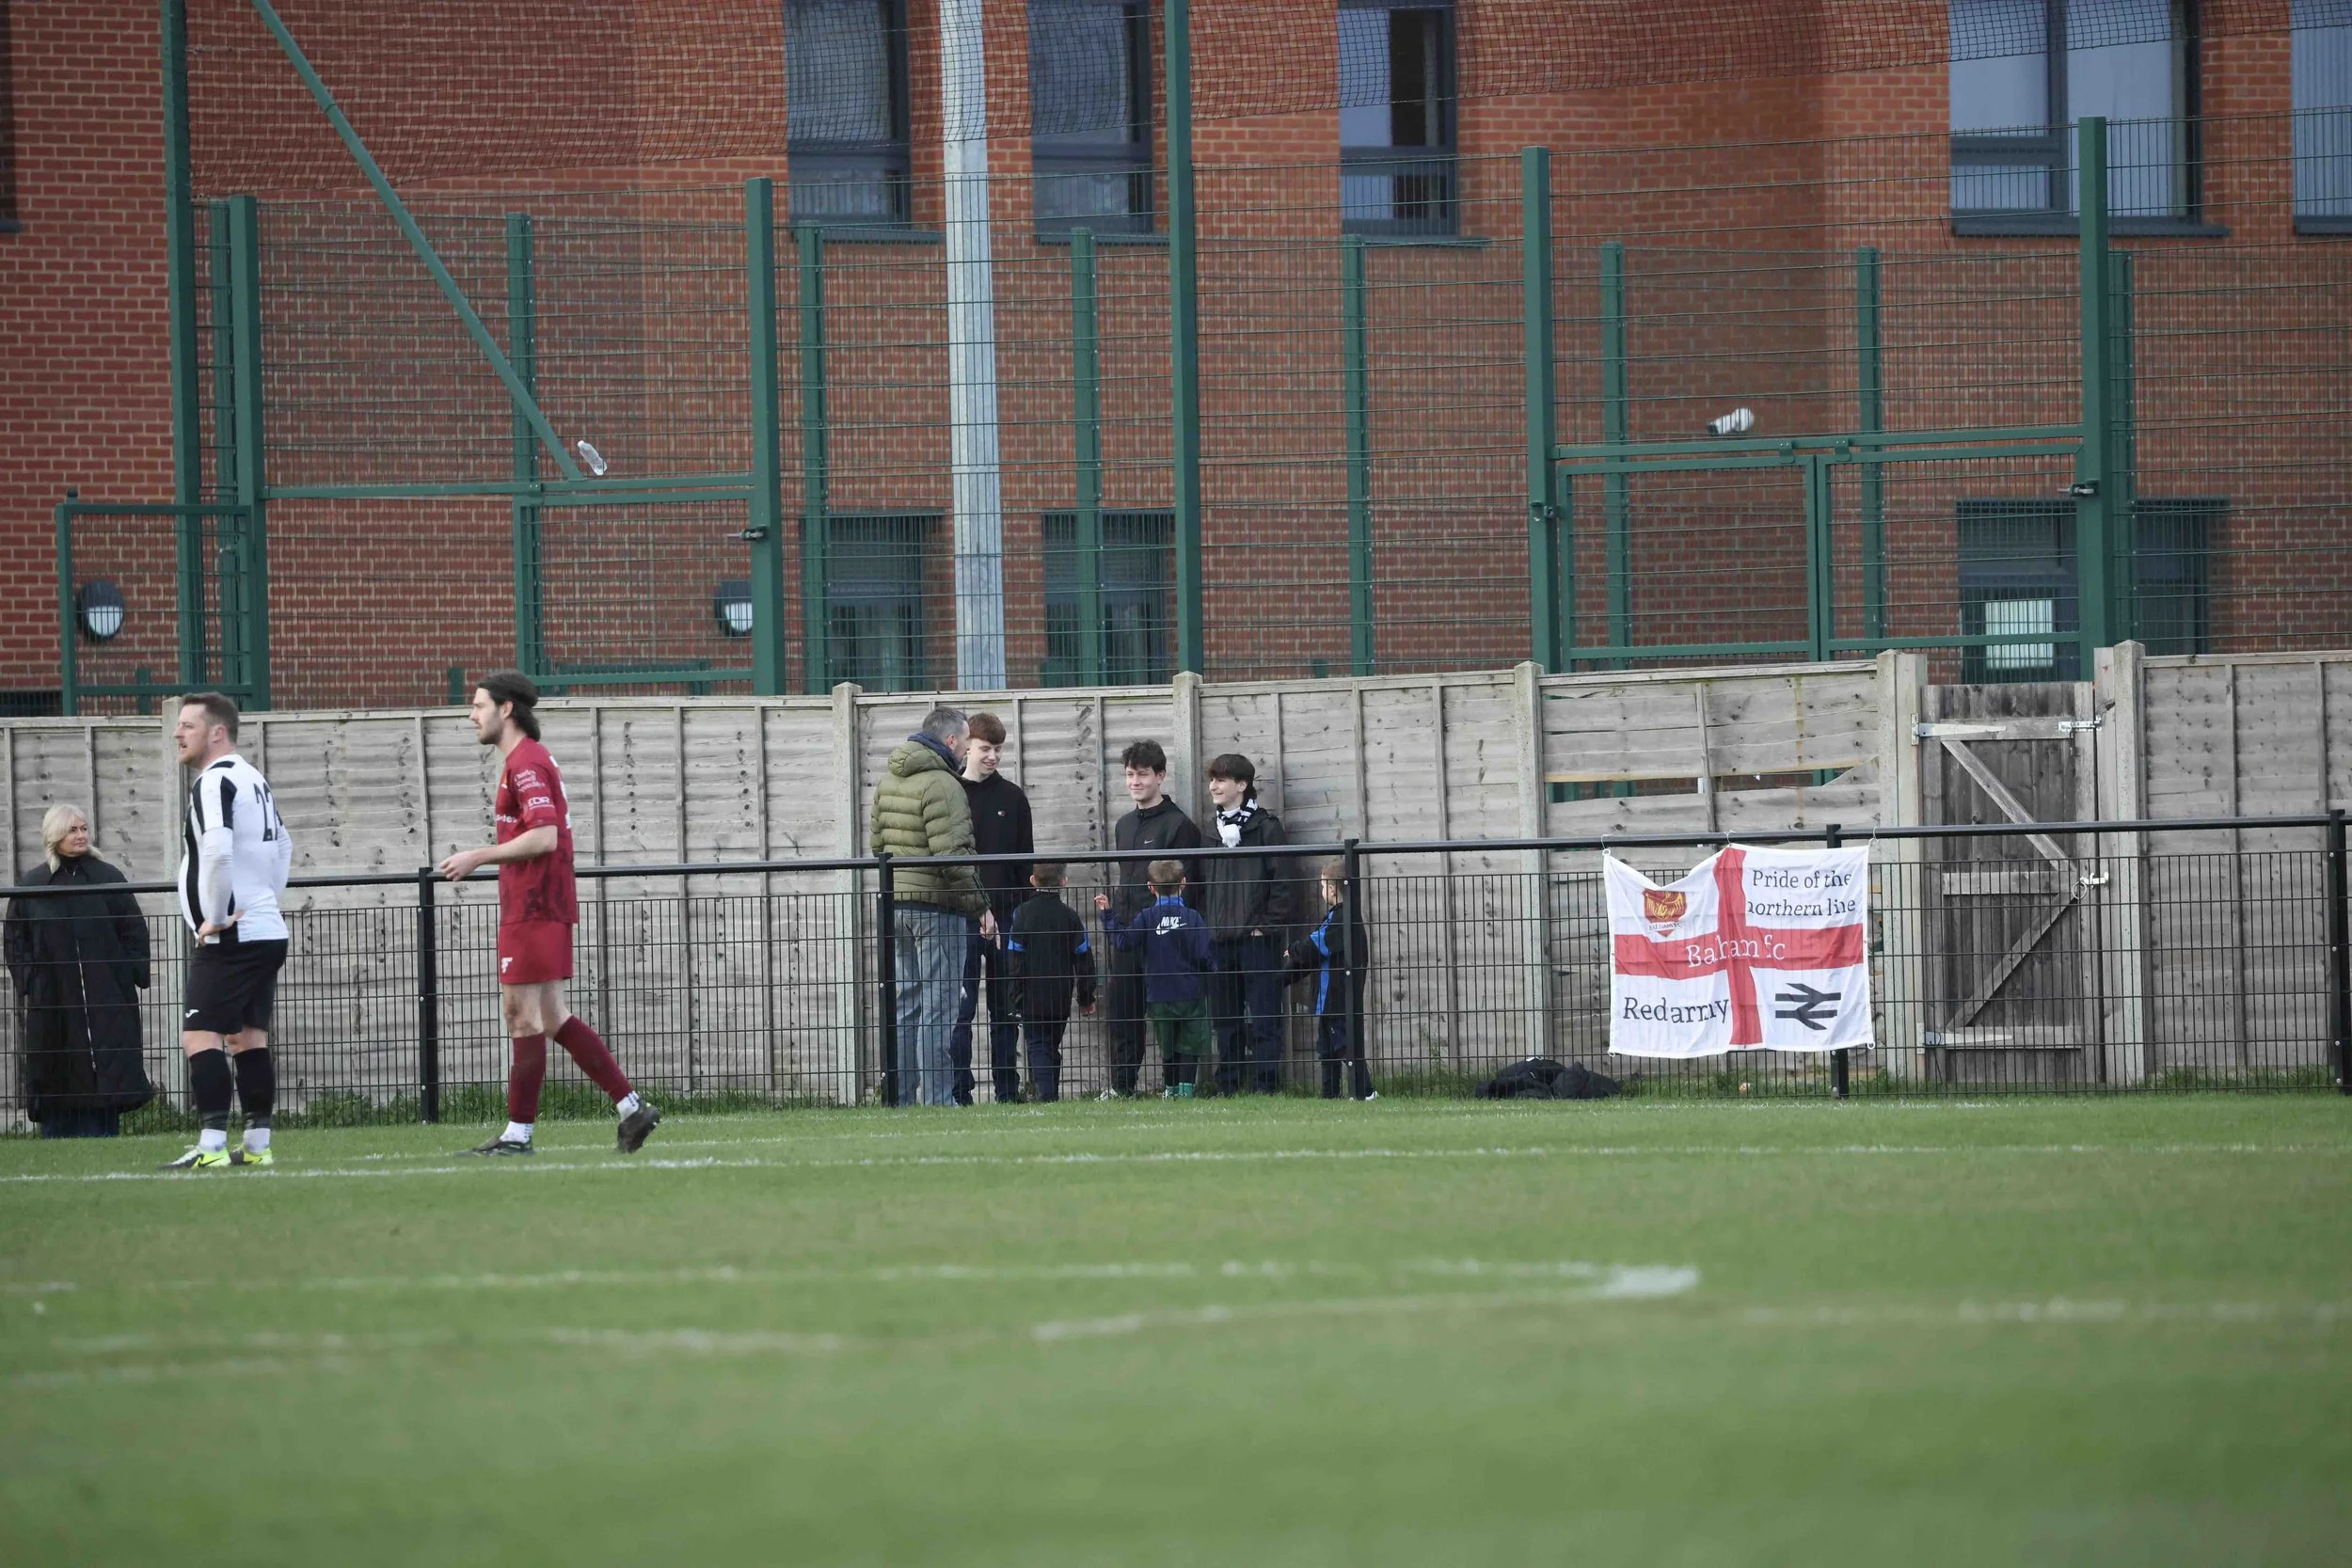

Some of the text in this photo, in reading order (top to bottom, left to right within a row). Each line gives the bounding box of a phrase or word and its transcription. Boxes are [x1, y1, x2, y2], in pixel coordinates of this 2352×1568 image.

[1753, 869, 1852, 889] Pride of the
[1747, 899, 1823, 916] northern
[1764, 934, 1786, 960] fc
